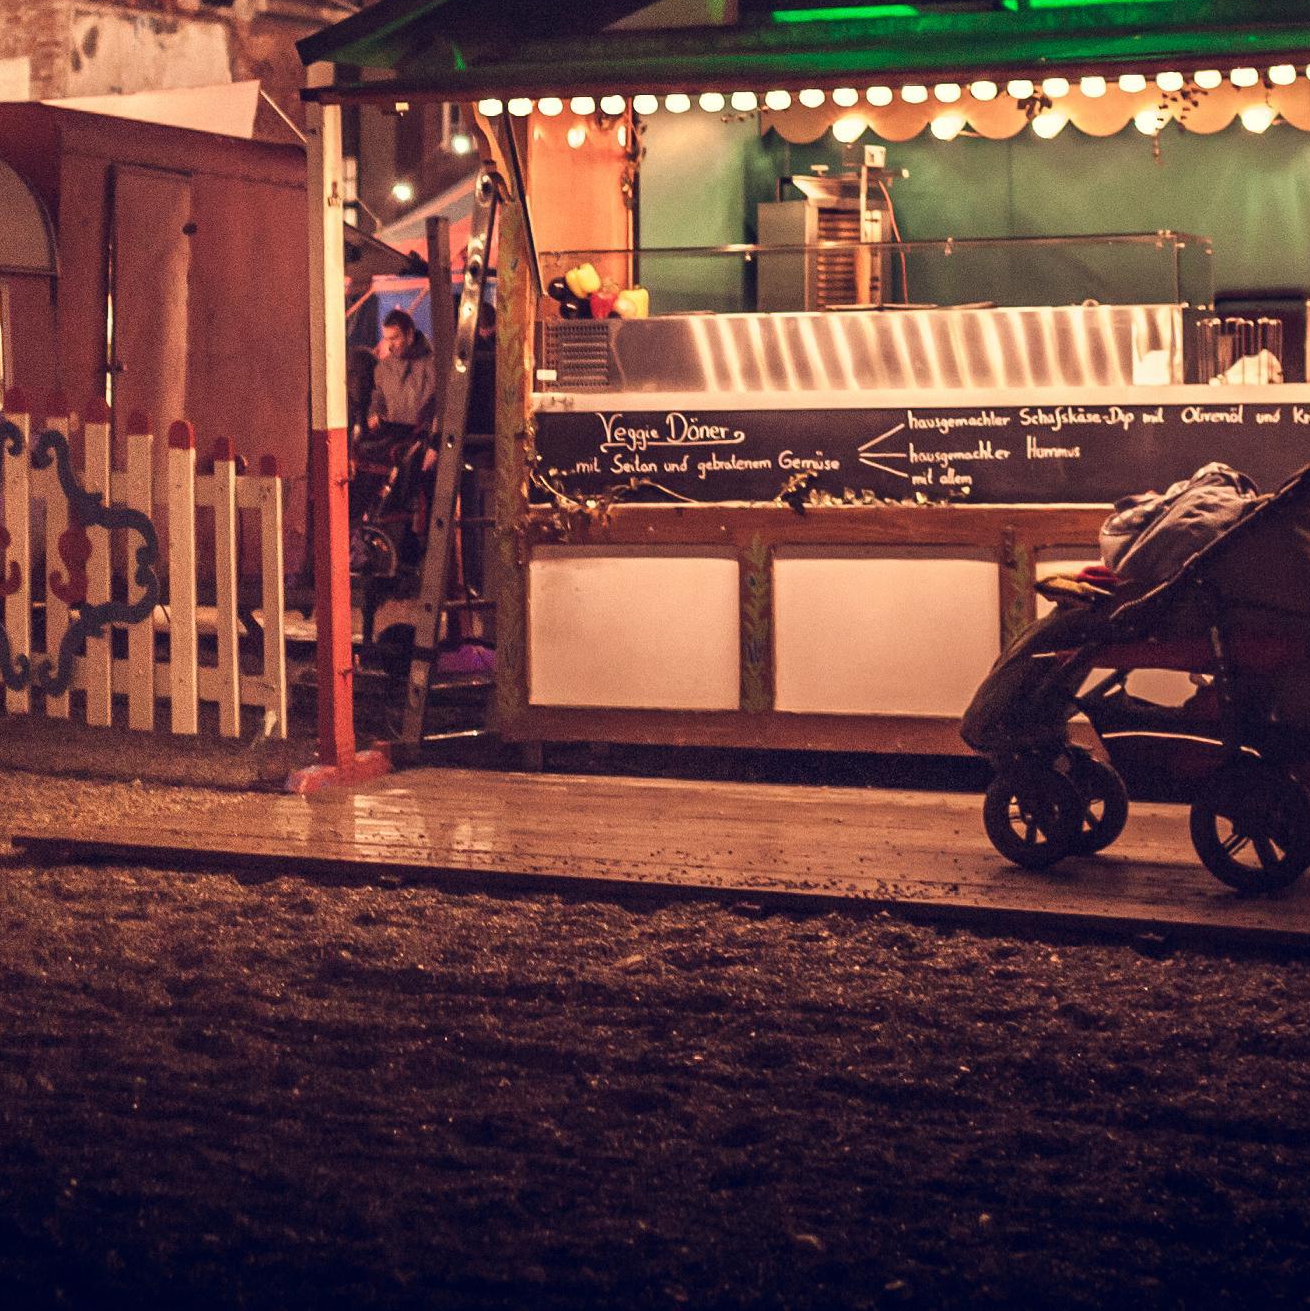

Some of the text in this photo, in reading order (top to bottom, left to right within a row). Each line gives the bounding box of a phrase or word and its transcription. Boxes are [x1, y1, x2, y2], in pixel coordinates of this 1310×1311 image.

[595, 412, 730, 451] Veggie Döner
[907, 409, 1011, 435] hausgemachter
[1142, 407, 1165, 423] mit
[1180, 404, 1244, 424] Olivenöl
[1255, 408, 1282, 424] und
[609, 452, 658, 474] Seitan
[663, 454, 689, 473] und
[697, 453, 772, 480] gebratenem
[777, 450, 840, 471] Gemüse
[908, 439, 1011, 468] hausgemachter
[911, 467, 934, 485] mit
